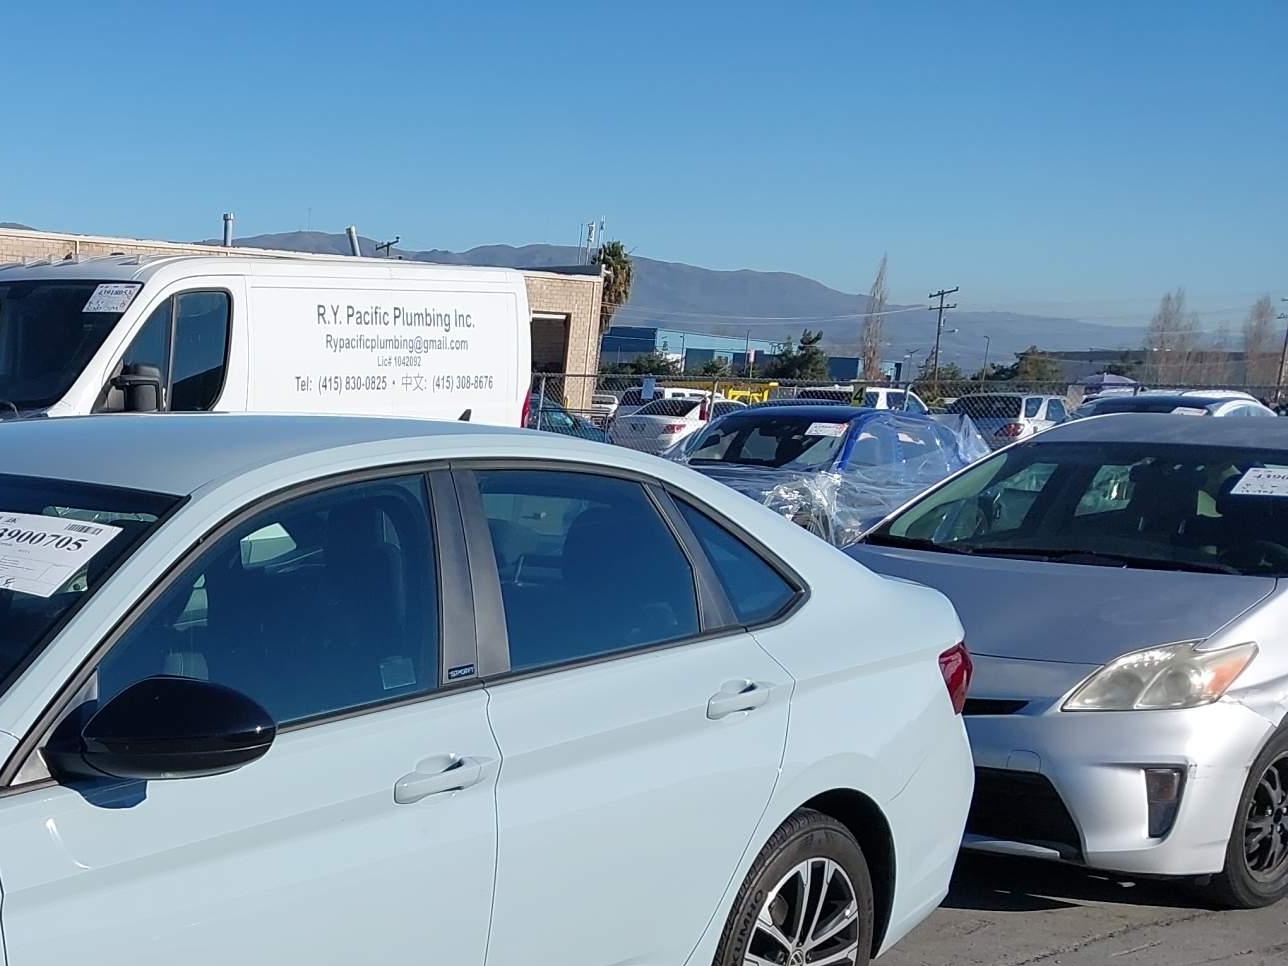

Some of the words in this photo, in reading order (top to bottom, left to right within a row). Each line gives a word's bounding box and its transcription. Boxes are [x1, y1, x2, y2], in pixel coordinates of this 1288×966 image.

[317, 304, 342, 325] R.Y.
[346, 305, 390, 326] Pacific
[393, 306, 451, 332] Plumbing
[454, 308, 475, 328] Inc.
[325, 333, 469, 354] Rypacificplumbing@gmail.com
[377, 355, 392, 367] Lic#
[394, 355, 422, 367] 1042092
[295, 375, 313, 392] Tel:
[318, 375, 343, 396] (415)
[345, 375, 387, 391] 830-0825
[432, 375, 454, 393] (415)
[456, 375, 493, 390] 308-8676
[853, 386, 864, 404] 4
